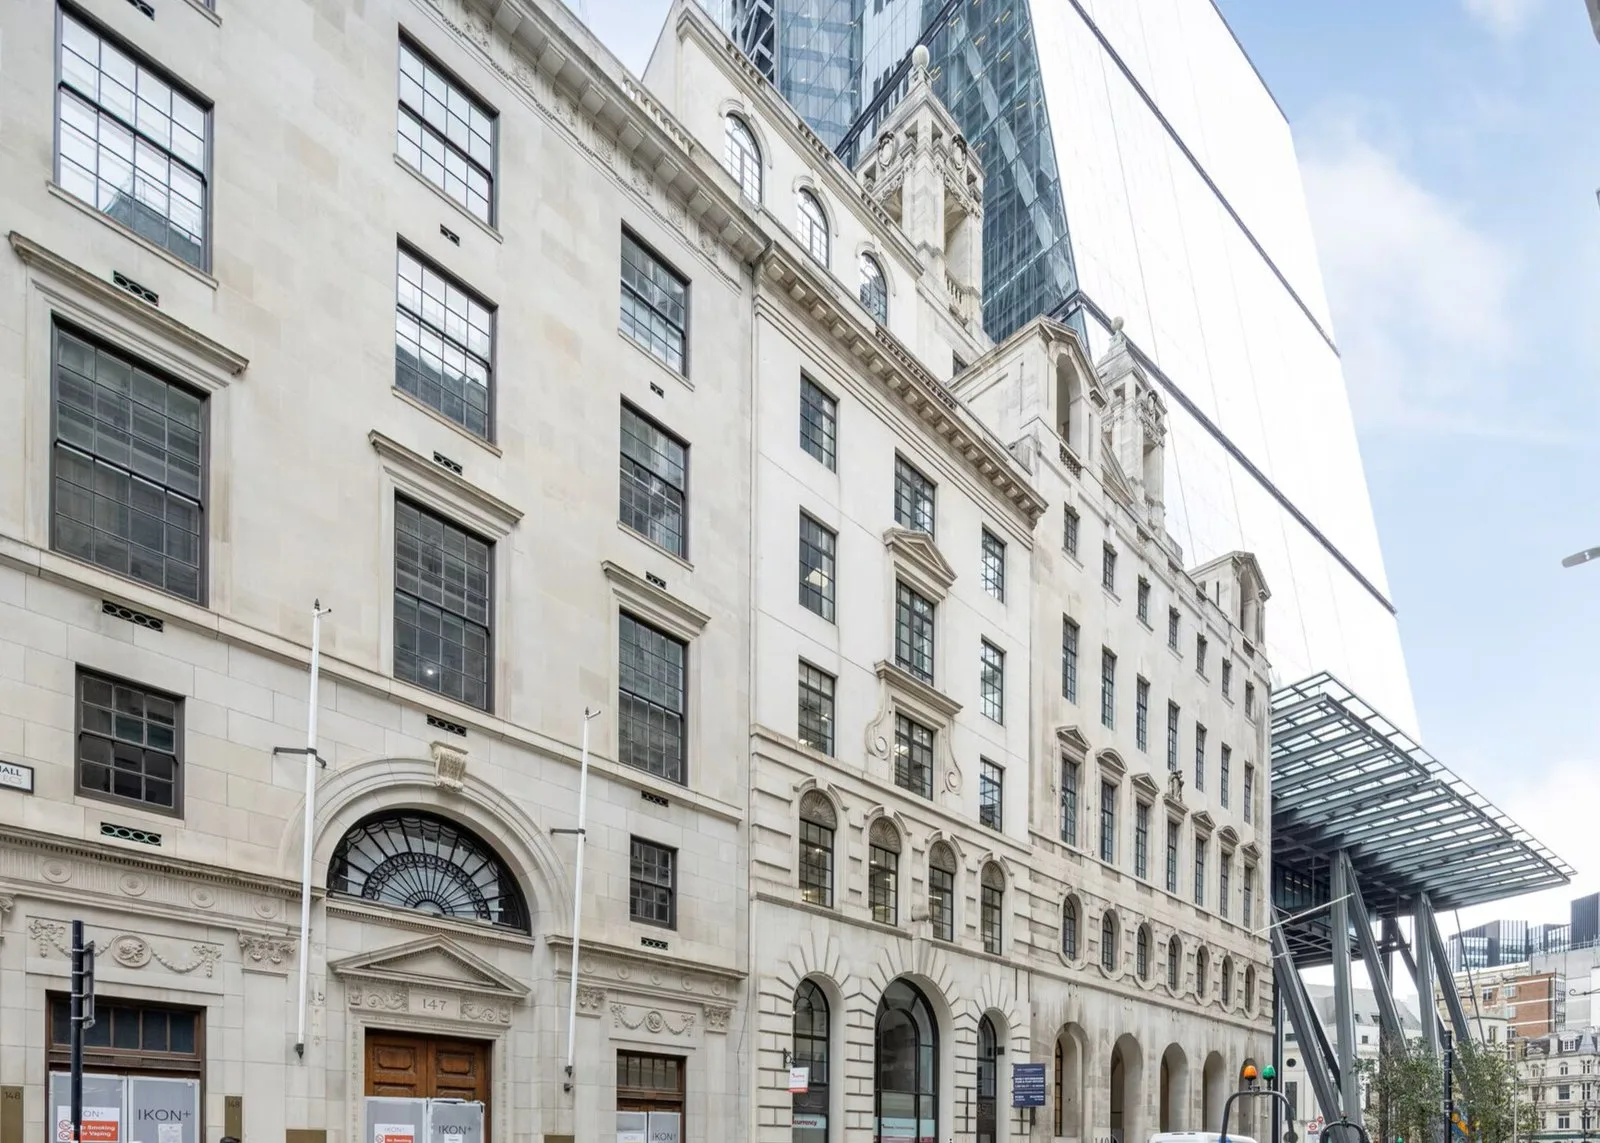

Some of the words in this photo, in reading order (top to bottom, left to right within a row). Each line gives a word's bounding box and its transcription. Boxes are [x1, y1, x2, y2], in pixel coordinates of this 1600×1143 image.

[423, 999, 447, 1010] 147
[5, 1091, 21, 1100] 148
[228, 1100, 240, 1108] 148
[138, 1109, 191, 1121] IKON+
